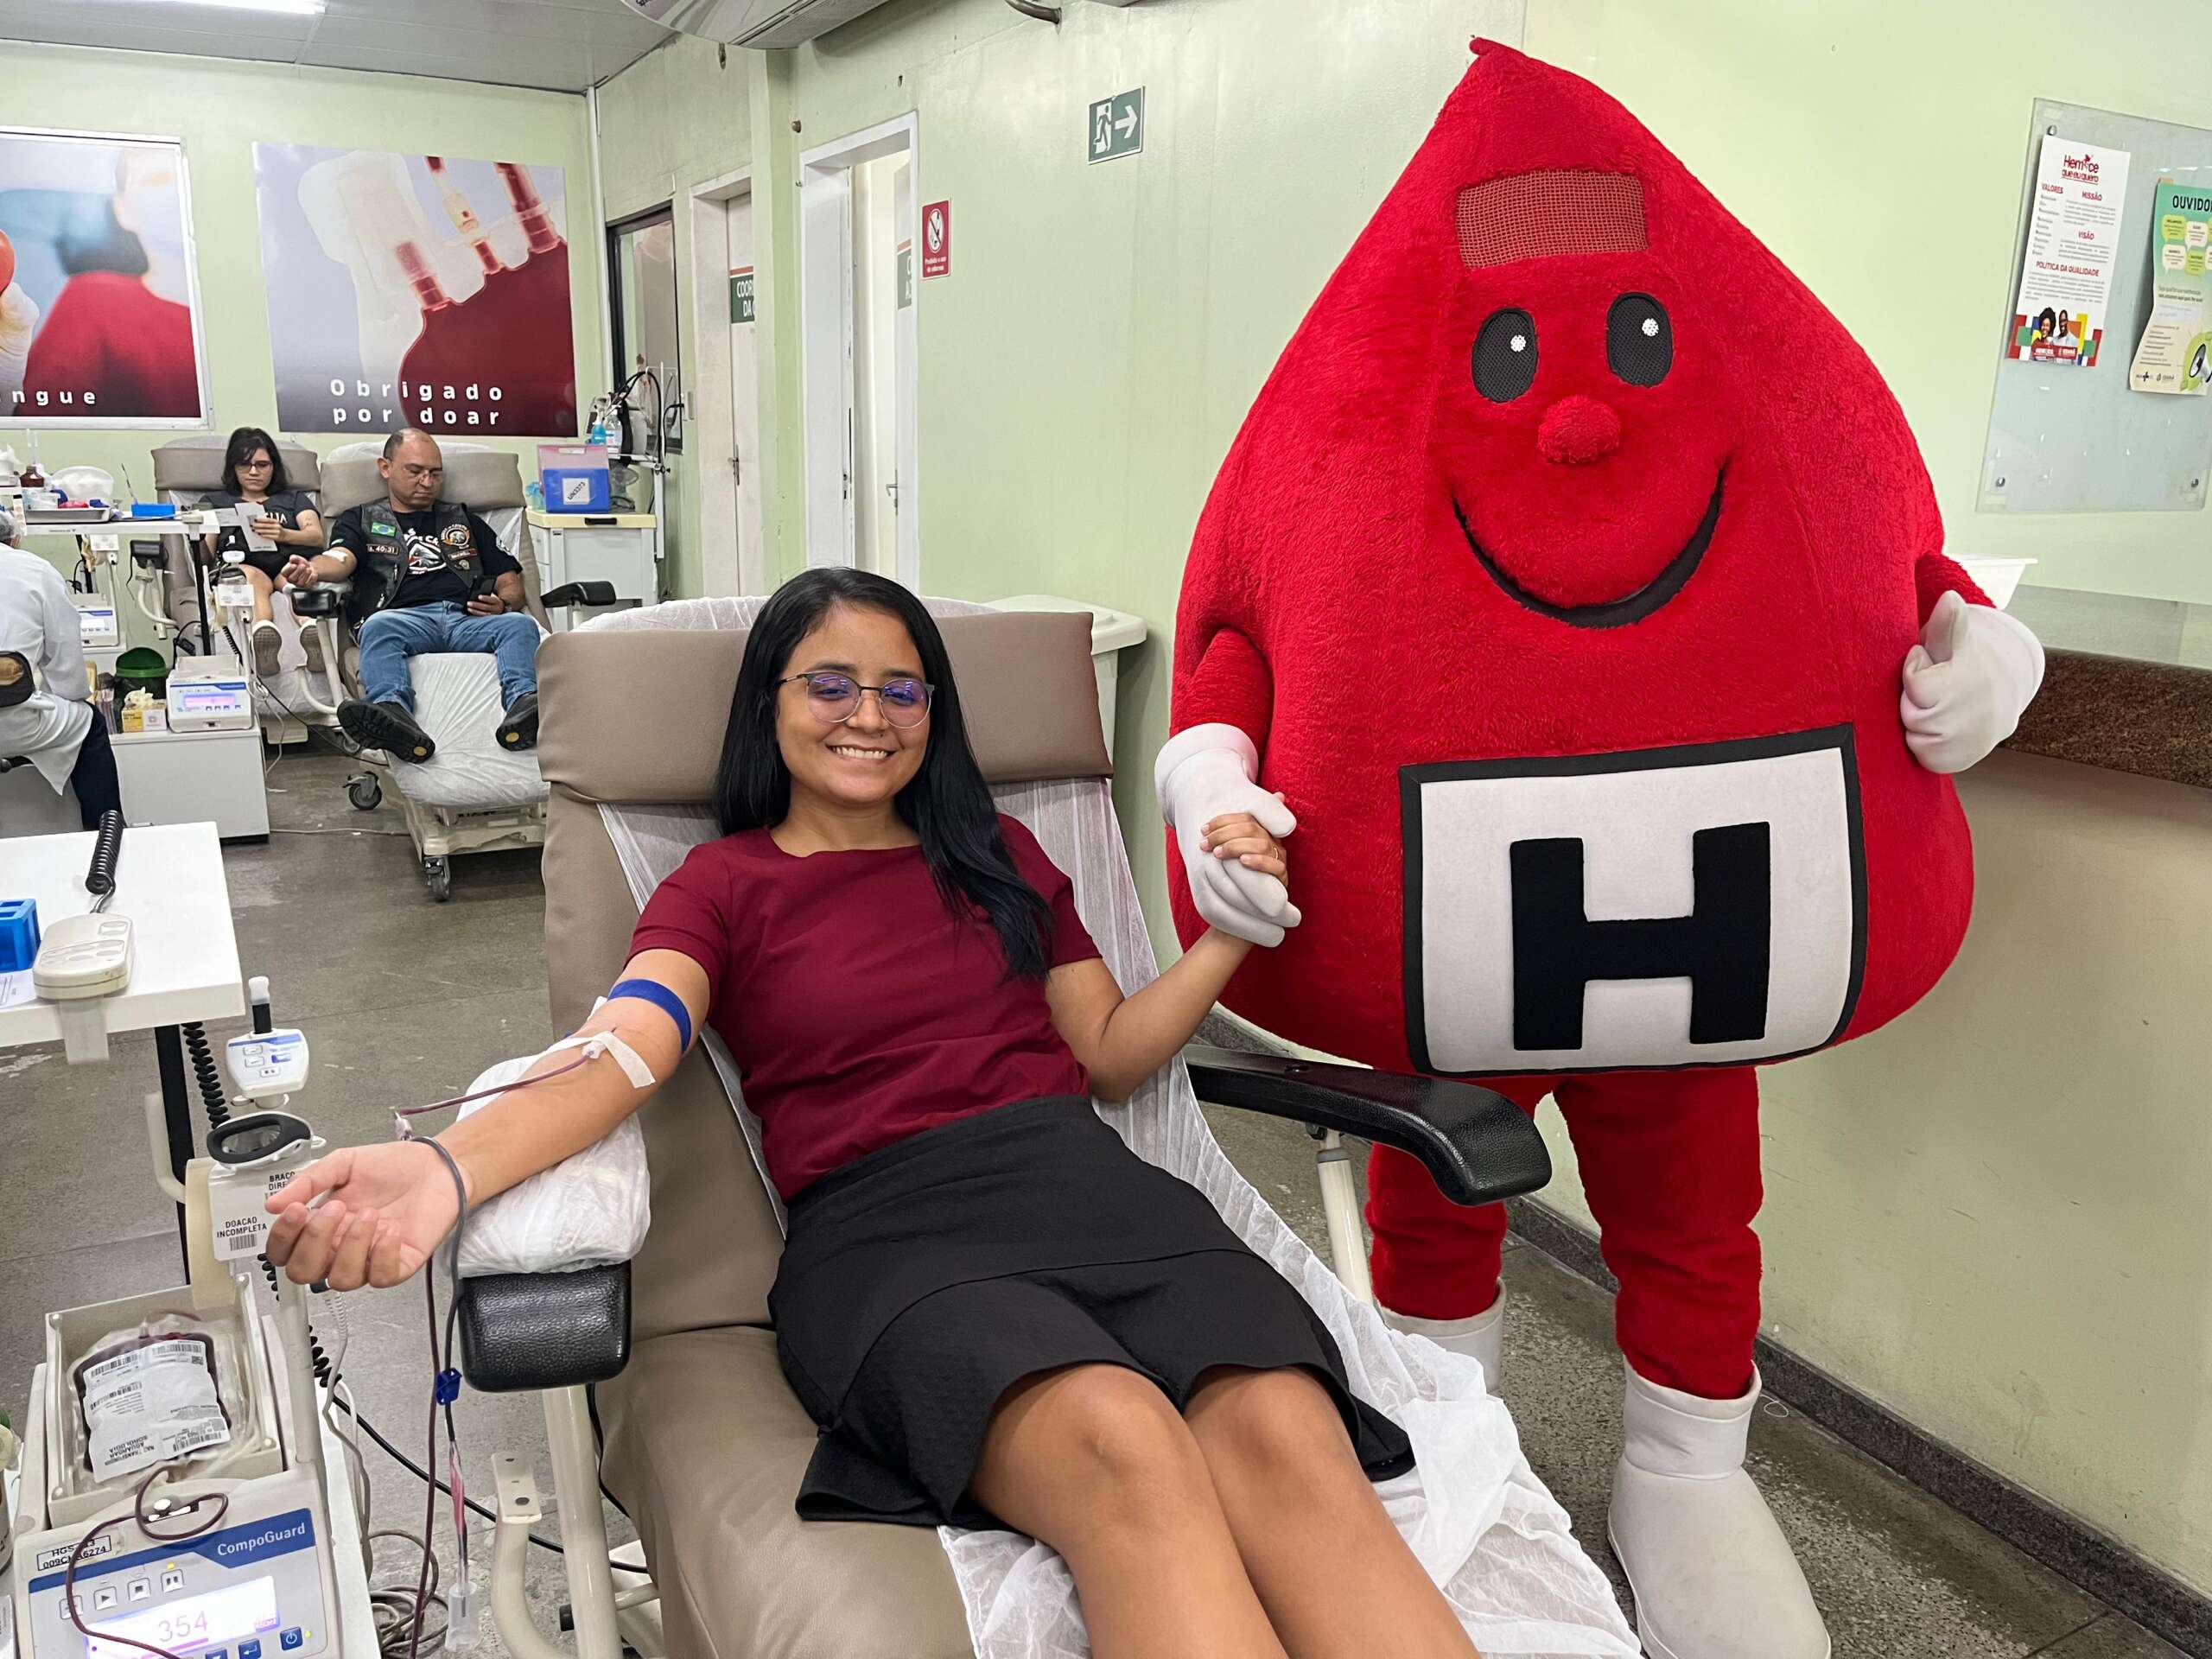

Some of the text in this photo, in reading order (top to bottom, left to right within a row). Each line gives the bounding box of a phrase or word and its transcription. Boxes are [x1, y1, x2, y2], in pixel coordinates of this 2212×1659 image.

[2042, 183, 2064, 194] VALORES
[2082, 190, 2103, 201] MISSÃO
[2172, 195, 2212, 213] OUVIDO
[2078, 230, 2094, 240] VISÃO
[0, 390, 96, 406] ngue
[330, 378, 502, 402] Obrigado
[333, 407, 499, 425] por doar
[1510, 822, 1770, 1051] H
[217, 1223, 267, 1238] INCOMPLETA
[226, 1217, 257, 1229] DOACAO
[217, 1522, 306, 1556] CompoGuard
[158, 1610, 209, 1643] 354
